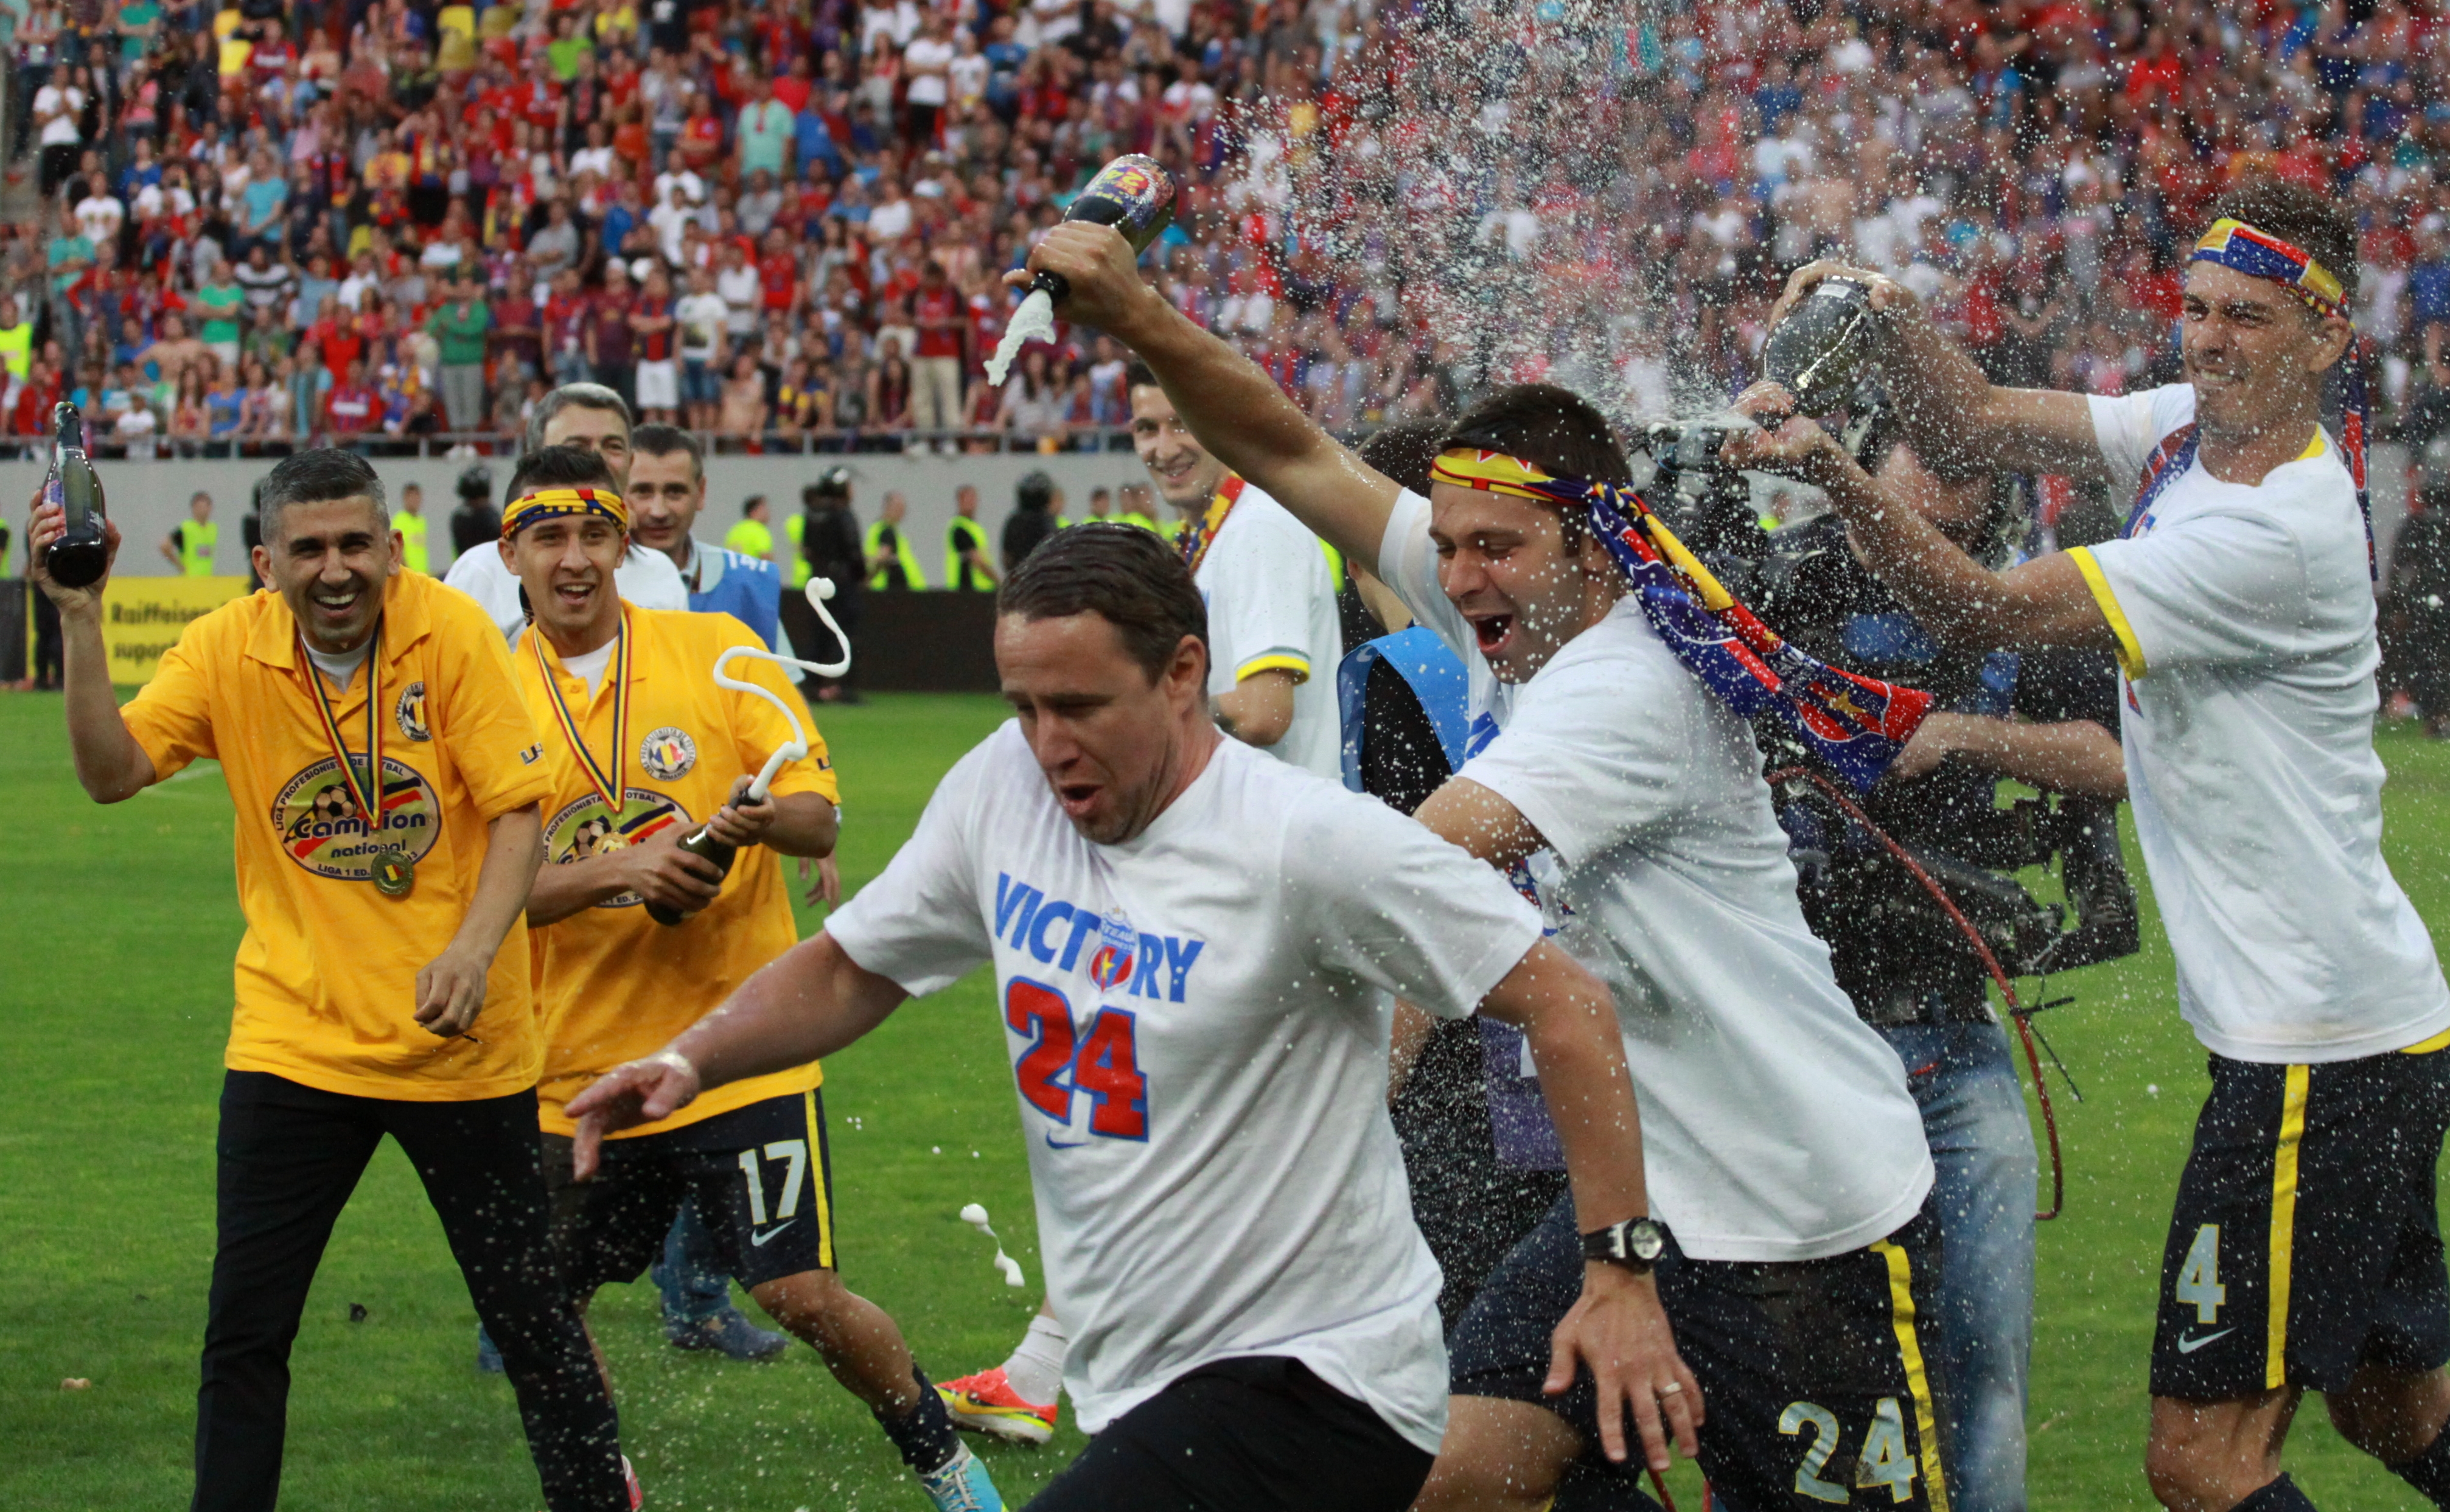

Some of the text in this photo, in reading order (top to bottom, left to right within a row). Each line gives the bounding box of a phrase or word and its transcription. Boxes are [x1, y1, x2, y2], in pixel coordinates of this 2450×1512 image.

[1105, 169, 1145, 187] 24
[276, 807, 284, 831] LIGA
[626, 792, 656, 803] OTBAL
[318, 864, 342, 875] LIGA
[1005, 975, 1149, 1142] 24
[739, 1139, 806, 1225] 17
[2176, 1224, 2227, 1325] 4
[1778, 1396, 1917, 1505] 24
